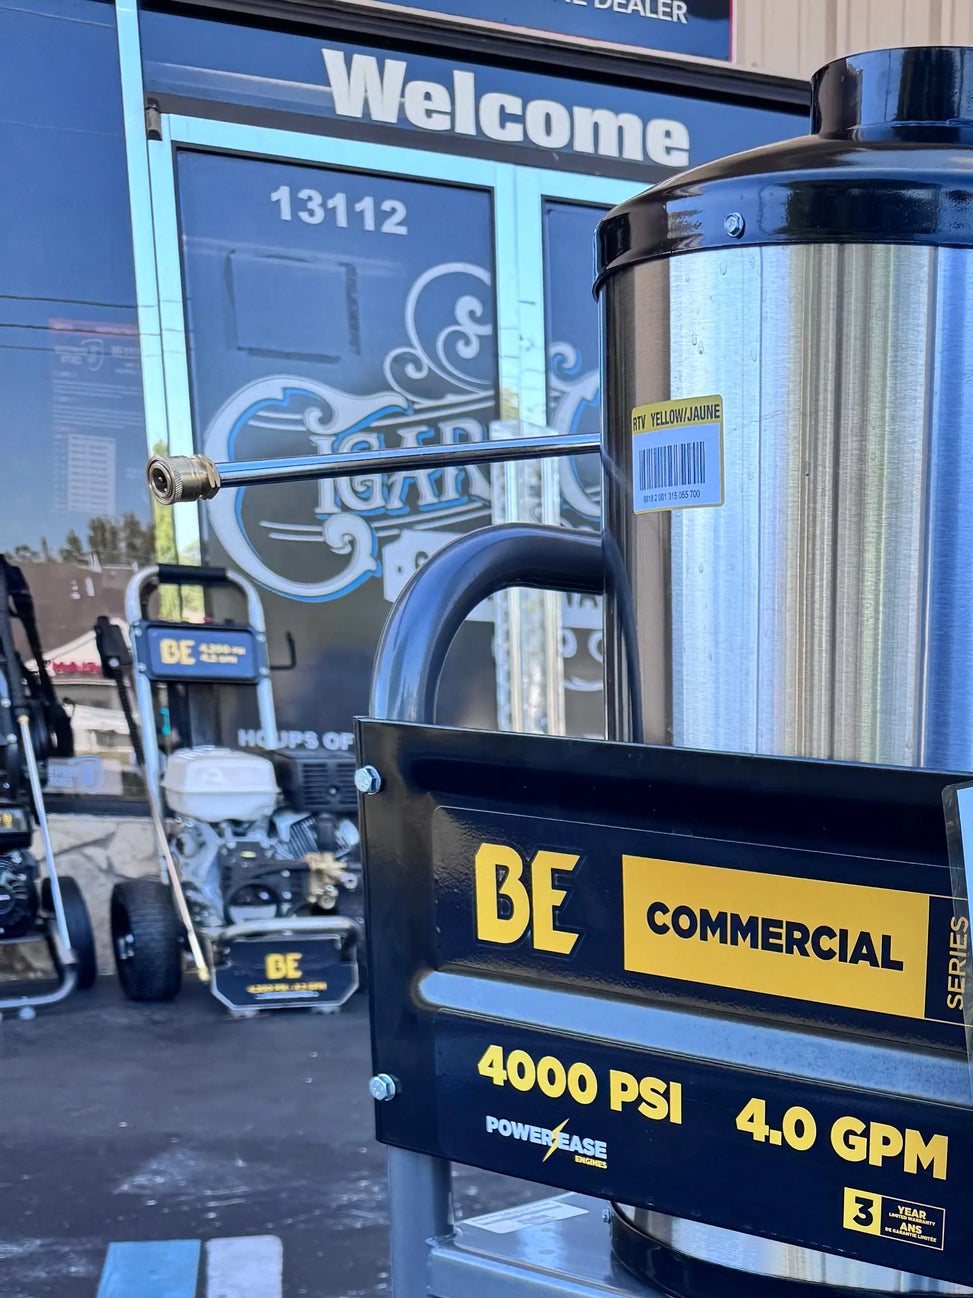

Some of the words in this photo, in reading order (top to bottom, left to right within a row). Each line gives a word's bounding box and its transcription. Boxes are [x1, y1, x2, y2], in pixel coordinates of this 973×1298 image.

[322, 48, 690, 167] Welcome
[270, 186, 408, 236] 13112
[632, 414, 646, 432] RTV
[650, 403, 720, 427] YELLOW/JAUNE
[160, 638, 197, 665] BE
[322, 731, 354, 751] OF
[475, 842, 581, 956] BE
[646, 901, 904, 973] COMMERCIAL
[265, 952, 303, 980] BE
[946, 915, 969, 1011] SERIES
[477, 1045, 599, 1105] 4000
[609, 1069, 683, 1125] PSI
[735, 1098, 817, 1151] 4.0
[830, 1116, 949, 1180] GPM
[575, 1155, 608, 1169] ENGINES
[852, 1195, 874, 1227] 3
[897, 1205, 927, 1220] YEAR
[899, 1222, 923, 1235] ANS
